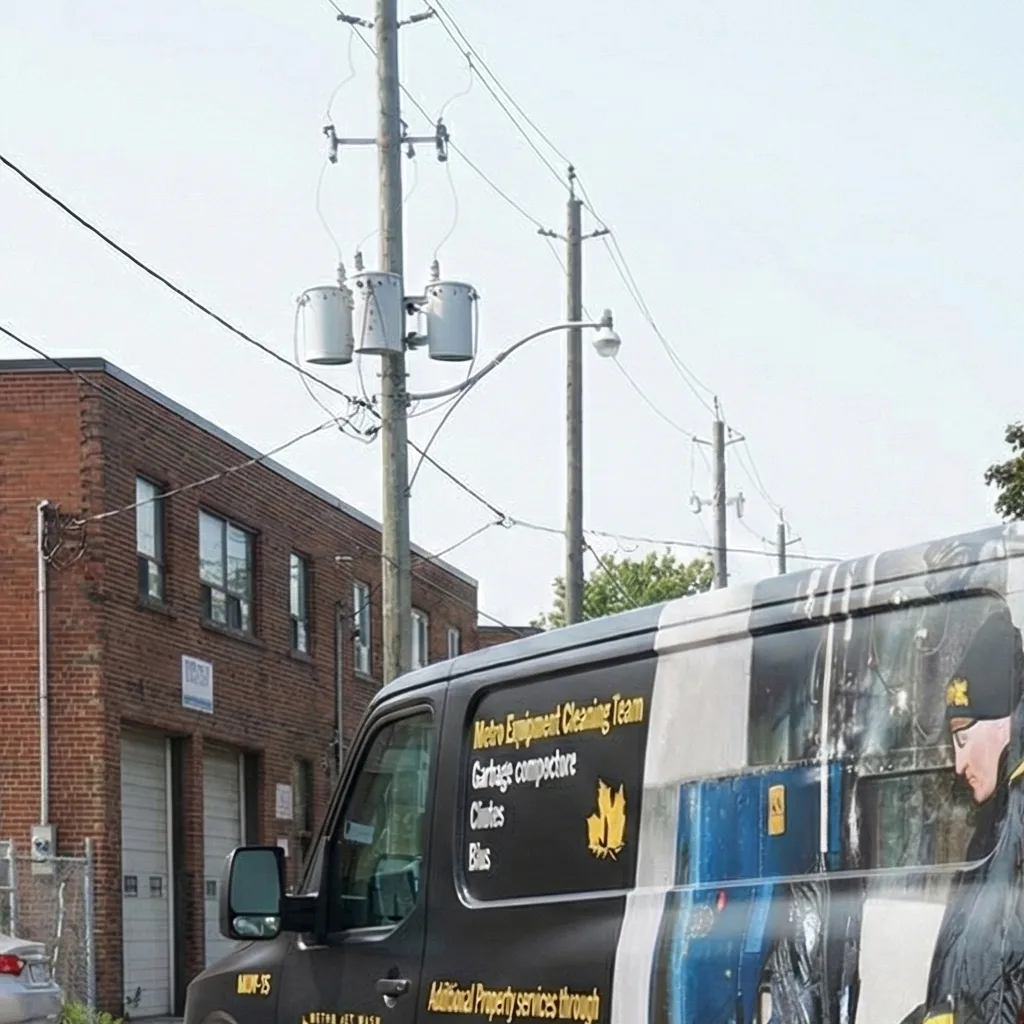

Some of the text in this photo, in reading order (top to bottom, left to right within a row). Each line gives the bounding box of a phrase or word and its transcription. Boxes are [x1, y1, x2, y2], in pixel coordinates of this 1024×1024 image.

[473, 718, 504, 749] Metro
[612, 693, 643, 725] Team
[475, 983, 516, 1023] Property
